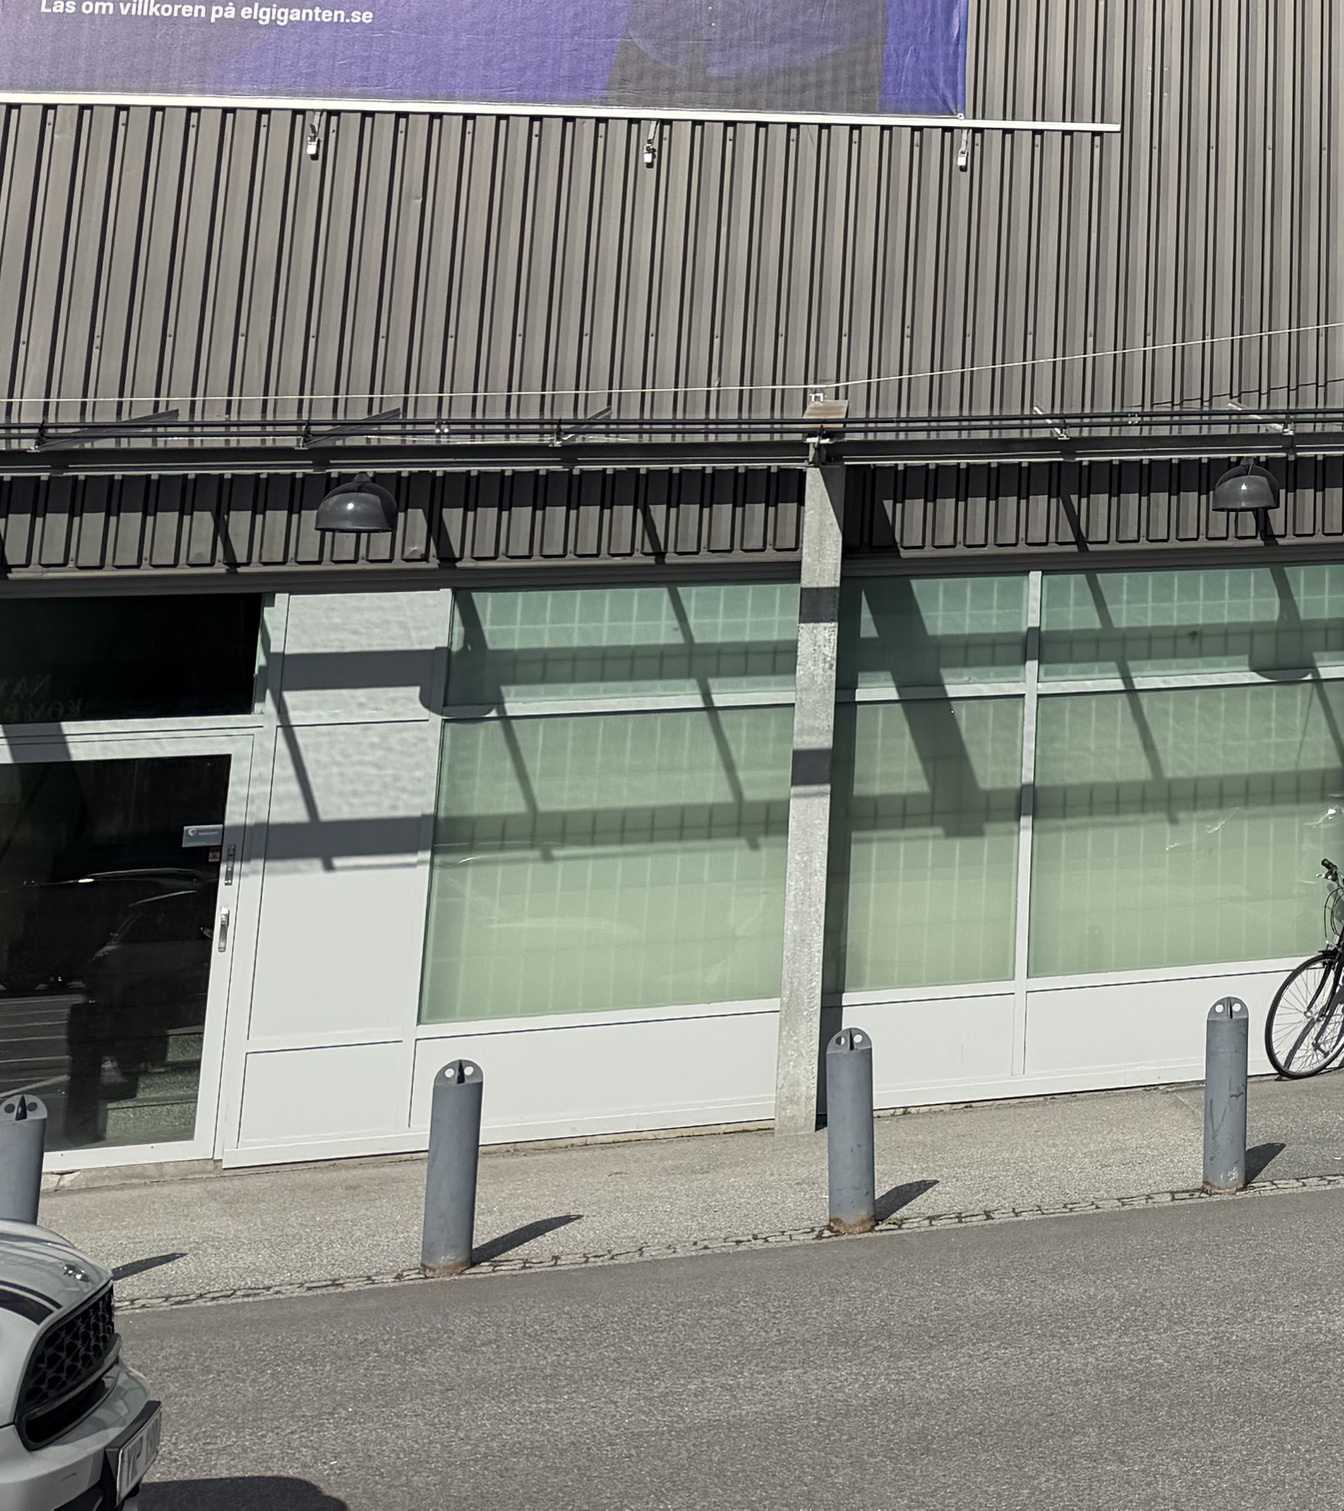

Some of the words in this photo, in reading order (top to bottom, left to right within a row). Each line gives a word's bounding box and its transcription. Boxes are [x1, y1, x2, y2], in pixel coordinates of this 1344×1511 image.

[81, 0, 114, 15] om
[210, 1, 236, 23] på
[240, 2, 374, 26] elgiganten.se
